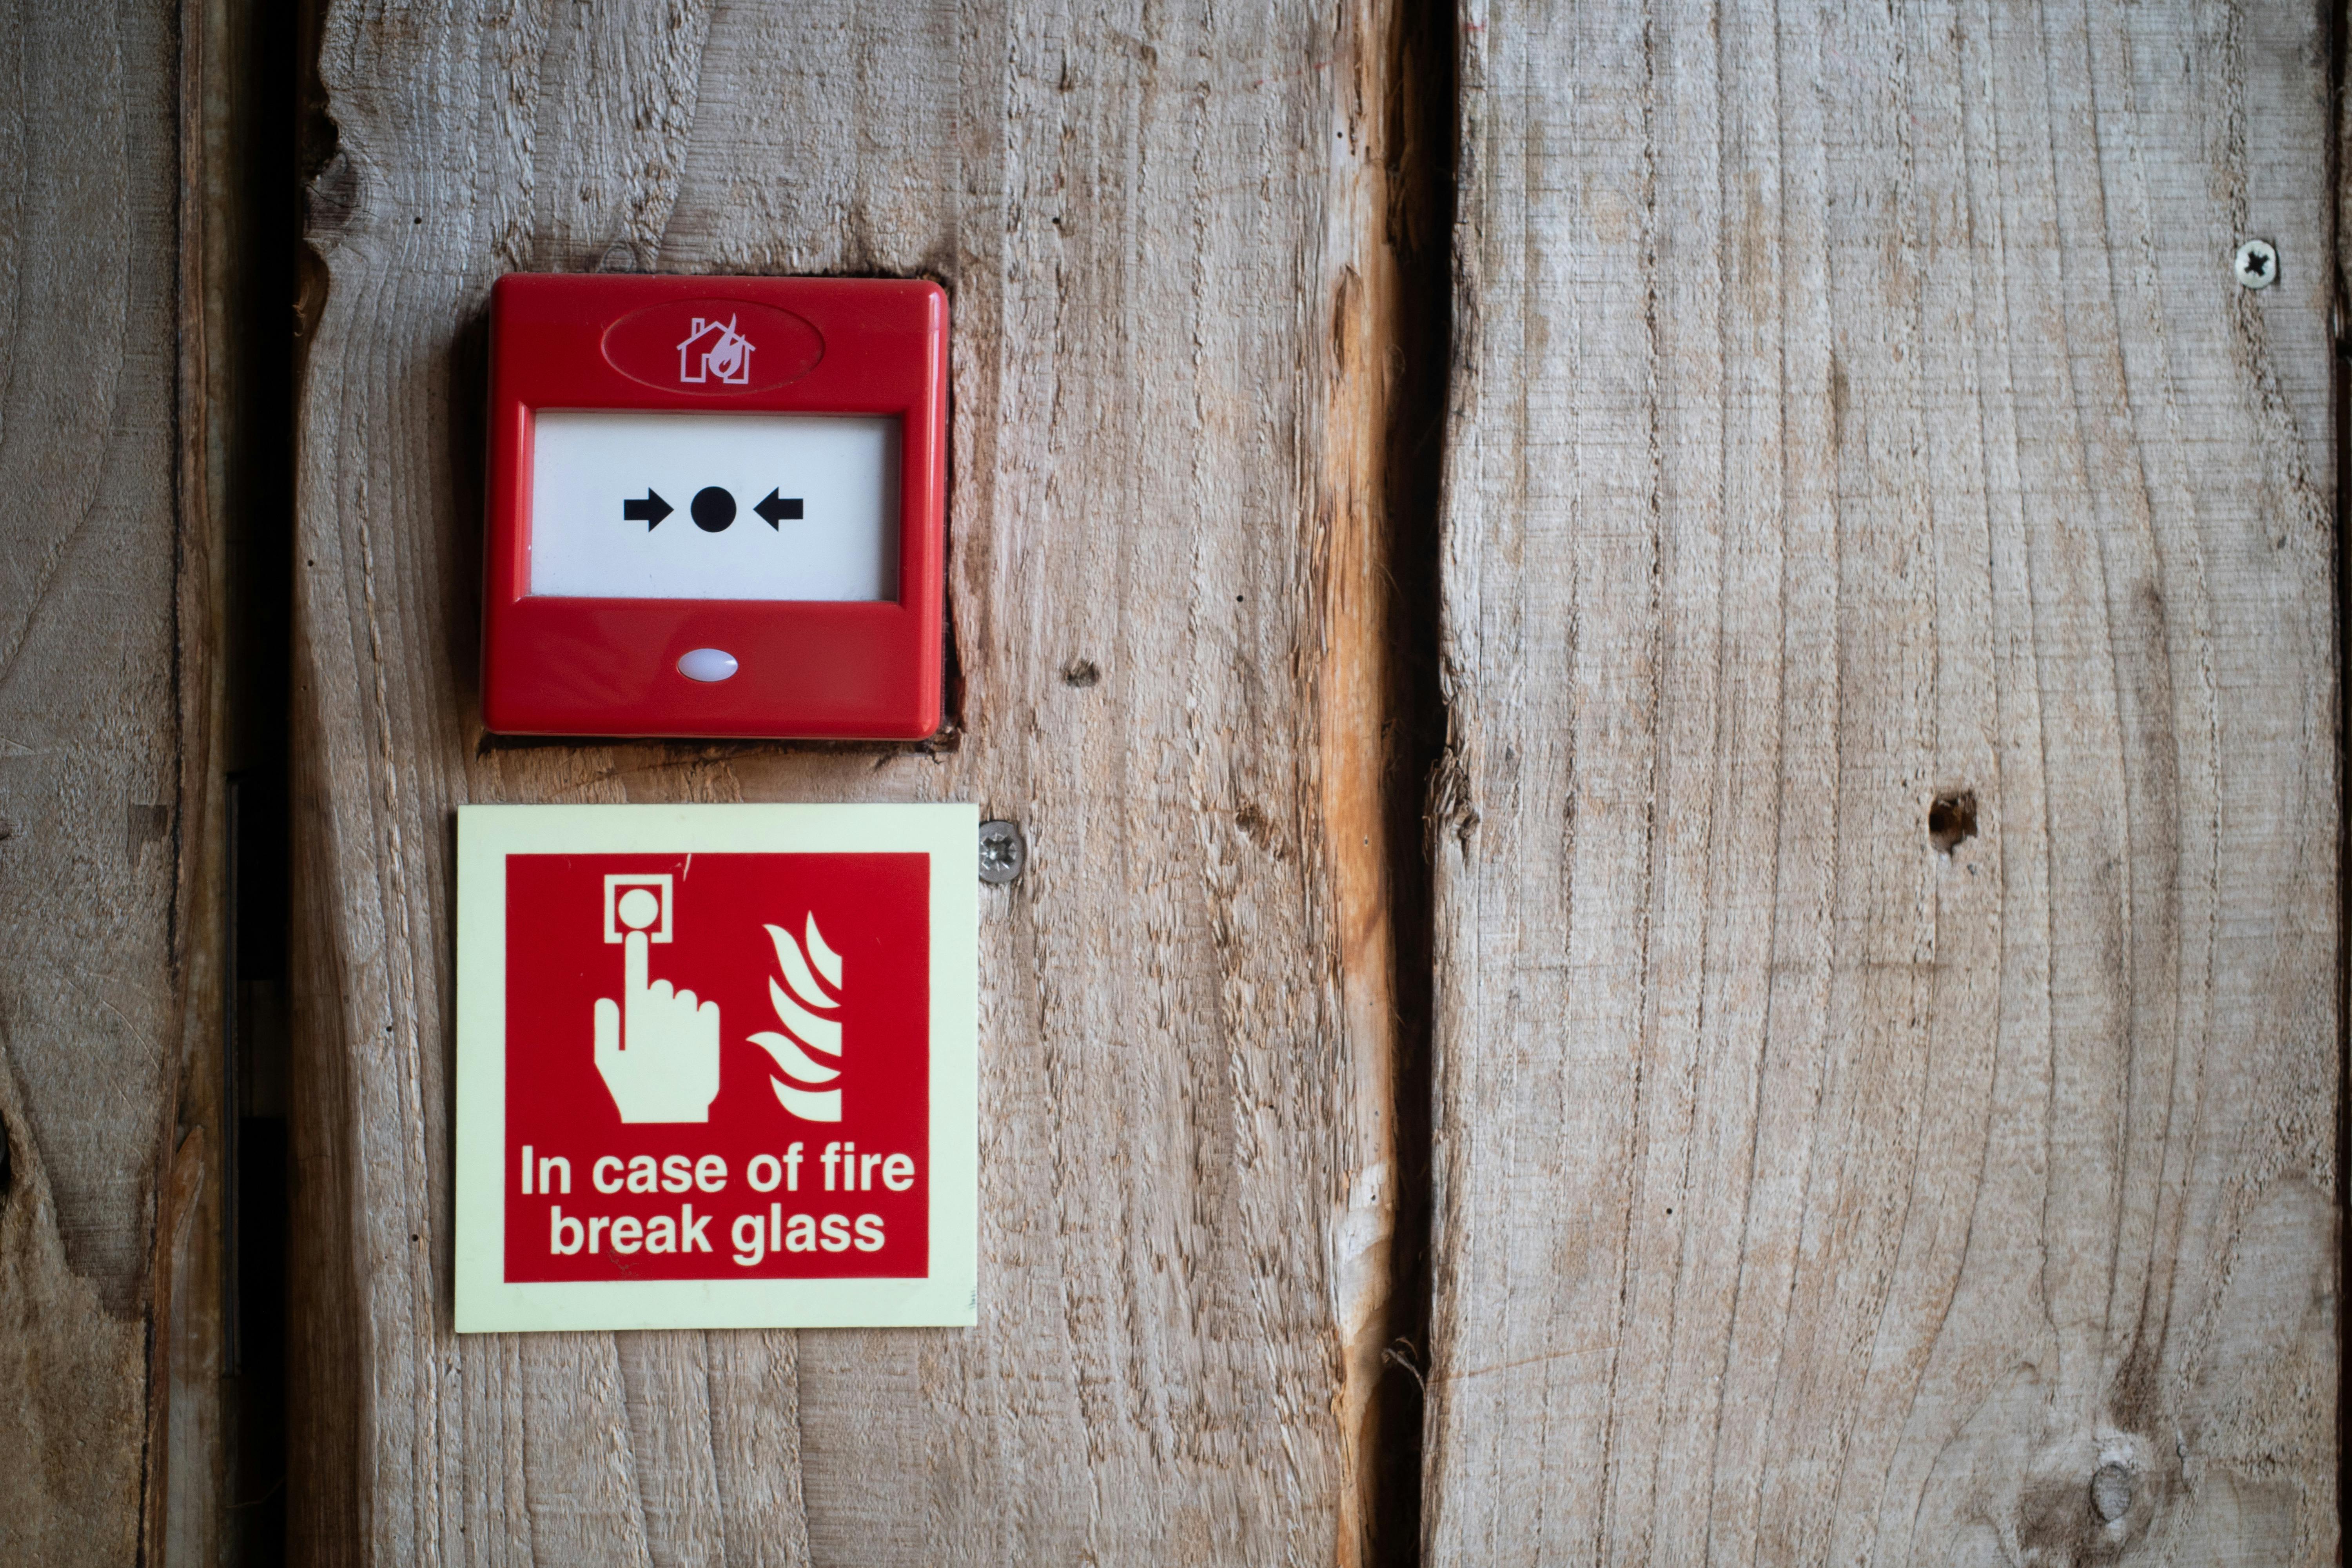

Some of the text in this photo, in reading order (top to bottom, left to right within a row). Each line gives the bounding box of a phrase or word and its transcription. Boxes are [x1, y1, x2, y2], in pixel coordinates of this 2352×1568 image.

[521, 1142, 915, 1194] In case of fire
[551, 1203, 885, 1266] break glass
